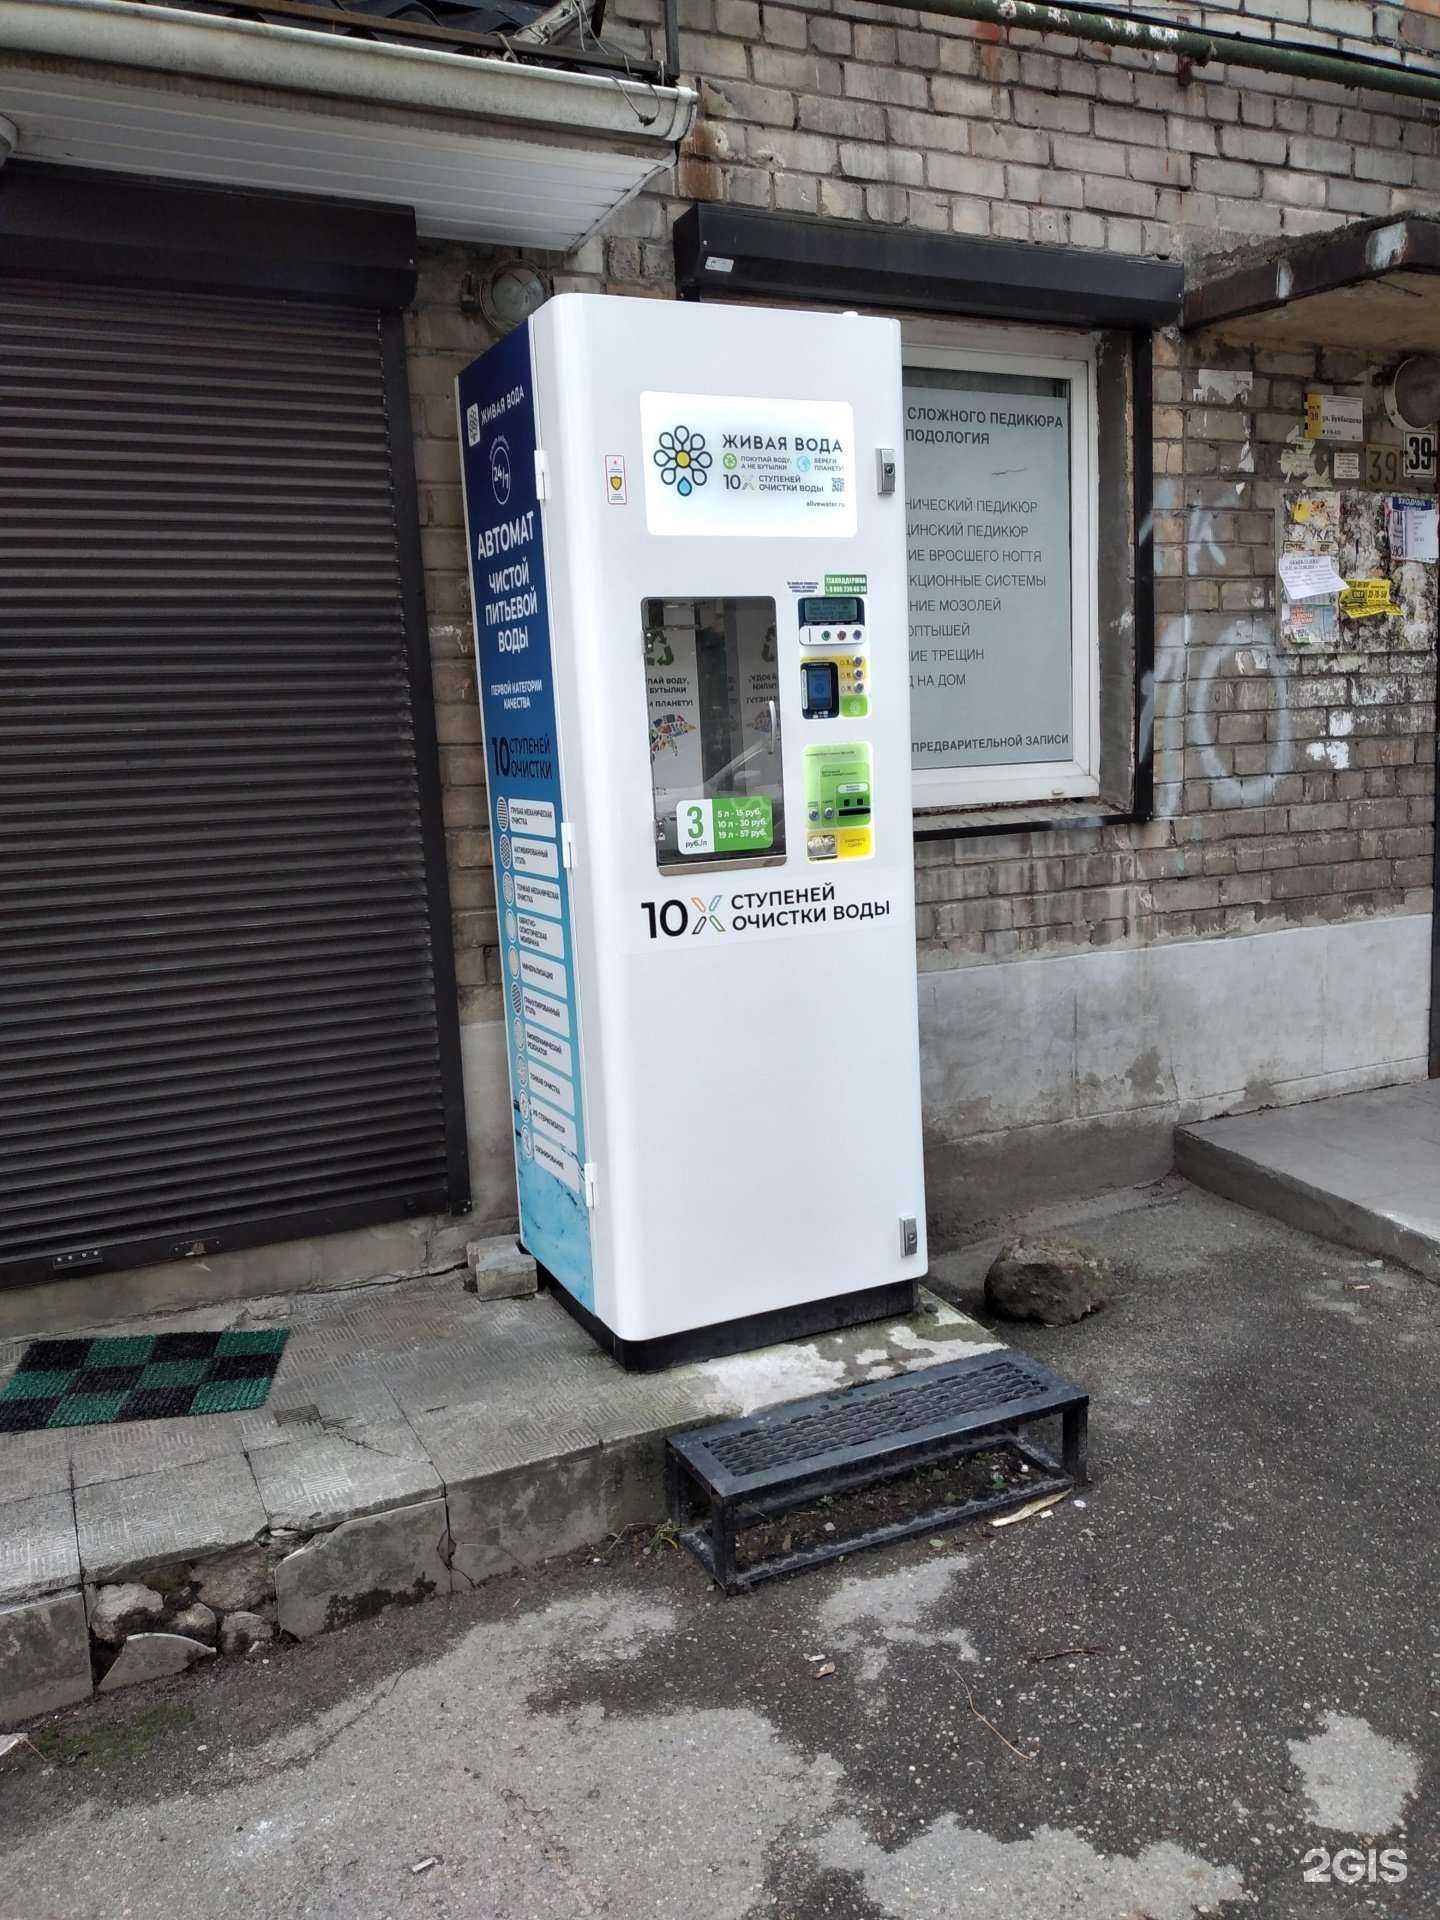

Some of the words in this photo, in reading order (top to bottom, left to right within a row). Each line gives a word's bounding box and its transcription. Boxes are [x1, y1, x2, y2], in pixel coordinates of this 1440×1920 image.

[481, 398, 506, 426] ЖИВАЯ
[507, 384, 525, 409] ВОДА
[907, 406, 986, 424] СЛОЖНОГО
[990, 412, 1064, 428] ПЕДИКЮРА
[722, 434, 787, 451] ЖИВАЯ
[795, 437, 843, 454] ВОДА
[906, 428, 990, 445] ПОДОЛОГИЯ
[740, 455, 772, 463] ПОКУПАЙ
[1408, 437, 1432, 471] 39
[1368, 450, 1397, 485] 39
[493, 464, 509, 489] 24/7
[759, 474, 801, 483] СТУПЕНЕЙ
[759, 484, 798, 492] ОЧИСТКИ
[800, 485, 824, 493] ВОДЫ
[976, 500, 1038, 514] ПЕДИКЮР
[477, 510, 534, 560] АВТОМАТ
[967, 524, 1029, 538] ПЕДИКЮР
[929, 550, 999, 562] ВРОСШЕГО
[1002, 550, 1042, 562] НОГТЯ
[489, 556, 530, 594] ЧИСТОЙ
[985, 574, 1046, 587] СИСТЕМЫ
[485, 585, 538, 626] ПИТЬЕВОЙ
[939, 597, 1001, 612] МОЗОЛЕЙ
[498, 625, 529, 654] ВОДЫ
[931, 649, 985, 663] ТРЕЩИН
[490, 680, 512, 696] ПЕРВОЙ
[512, 679, 543, 694] КАТЕГОРИИ
[666, 677, 690, 685] ВОДУ,
[917, 675, 935, 686] НА
[938, 674, 966, 687] ДОМ
[649, 686, 687, 694] БУТЫЛКИ
[503, 696, 531, 710] КАЧЕСТВА
[655, 699, 693, 708] ПЛАНЕТУ!
[510, 733, 551, 754] СТУПЕНЕЙ
[912, 735, 1023, 753] ПРЕДВАРИТЕЛЬНОЙ
[1025, 734, 1069, 746] ЗАПИСИ
[492, 736, 511, 776] 10
[511, 760, 552, 779] ОЧИСТКИ
[745, 808, 762, 817] руб.
[687, 806, 704, 839] 3
[718, 821, 726, 829] 10
[727, 821, 734, 829] л
[751, 818, 768, 827] руб.
[719, 831, 727, 839] 19
[728, 831, 734, 839] л
[740, 830, 749, 838] 57
[750, 828, 767, 838] руб.
[685, 839, 707, 849] руб./л
[731, 882, 835, 910] СТУПЕНЕЙ
[732, 908, 827, 931] ОЧИСТКИ
[832, 900, 890, 921] ВОДЫ
